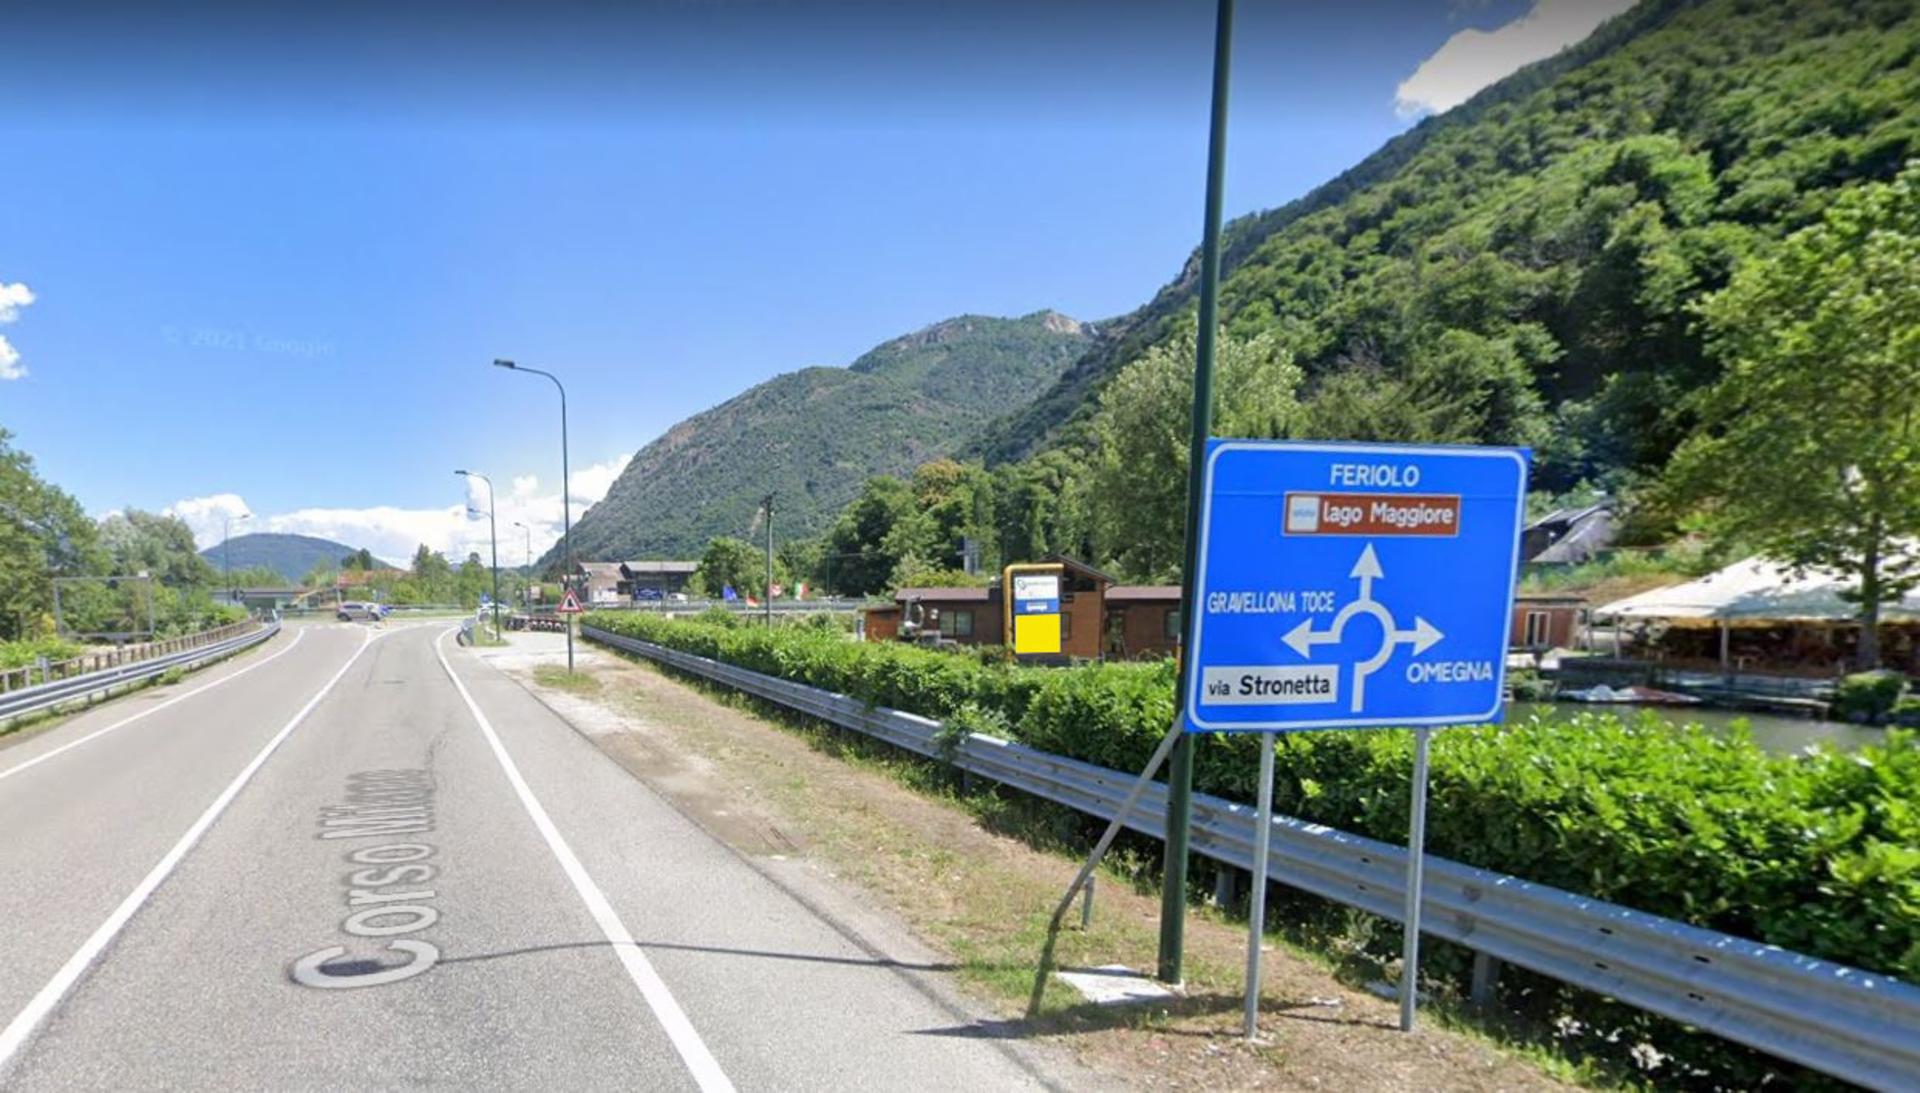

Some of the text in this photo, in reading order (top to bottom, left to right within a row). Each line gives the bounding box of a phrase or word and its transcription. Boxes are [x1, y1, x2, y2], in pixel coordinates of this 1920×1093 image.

[1330, 464, 1420, 487] FERIOLO
[1370, 501, 1454, 528] Maggiore
[1207, 591, 1335, 614] GRAVELLONA TOCE
[1406, 661, 1494, 683] OMEGNA
[1209, 675, 1330, 695] via Stronetta
